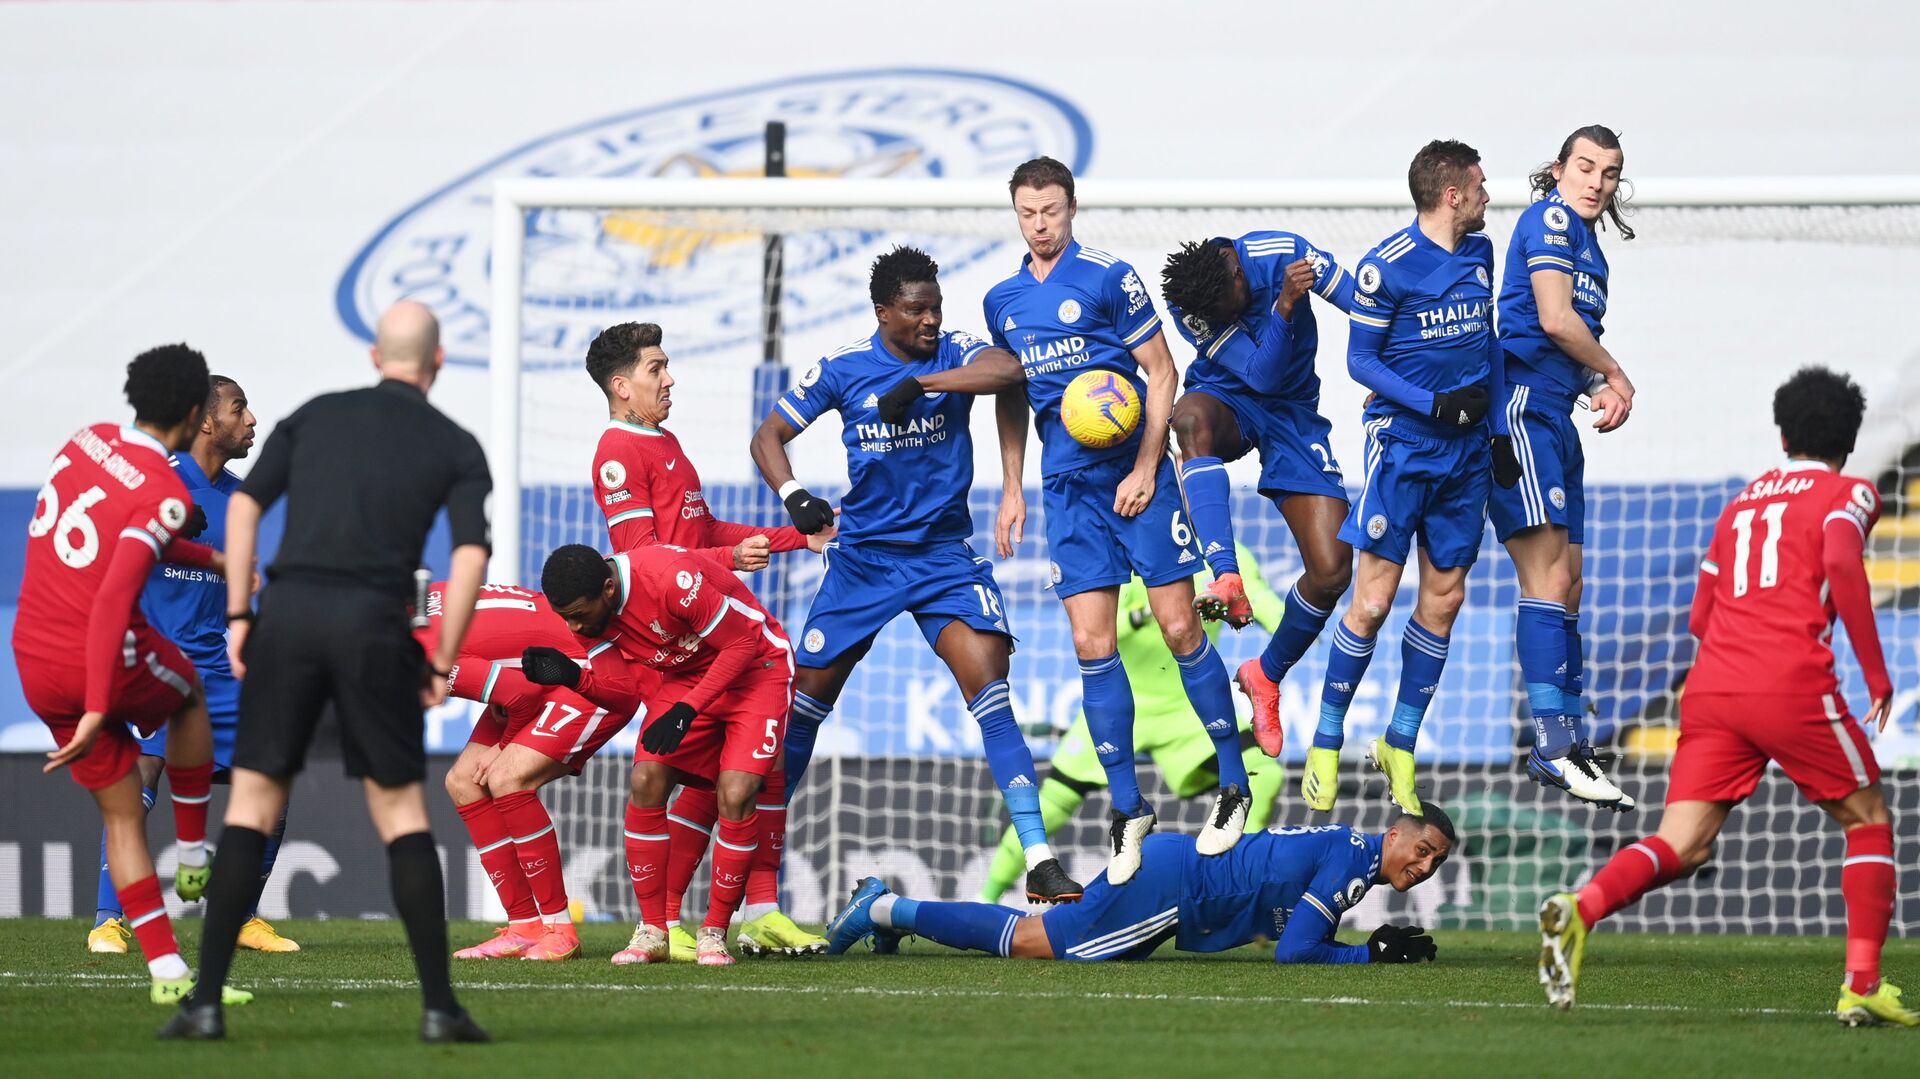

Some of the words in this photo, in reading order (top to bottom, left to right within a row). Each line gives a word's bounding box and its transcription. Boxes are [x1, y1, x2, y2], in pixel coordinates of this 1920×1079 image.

[1128, 295, 1149, 316] SAIGO
[1573, 289, 1598, 307] MILES
[1417, 302, 1488, 327] THAILAN
[1421, 325, 1459, 340] SMILES
[1463, 321, 1481, 334] WITH
[1021, 337, 1085, 365] AILAND
[1036, 360, 1063, 375] WITH
[1064, 352, 1090, 367] YOU
[856, 414, 945, 440] THAILAND
[861, 441, 893, 453] SMILES
[894, 437, 923, 449] WITH
[926, 431, 946, 445] YOU
[29, 454, 107, 568] 66
[1171, 511, 1191, 546] 6
[1732, 502, 1788, 598] 11
[164, 567, 203, 582] SMILES
[679, 571, 704, 608] Expedia
[973, 584, 1004, 618] 18
[426, 590, 443, 616] JONES
[535, 700, 583, 733] 17
[762, 718, 779, 754] 5
